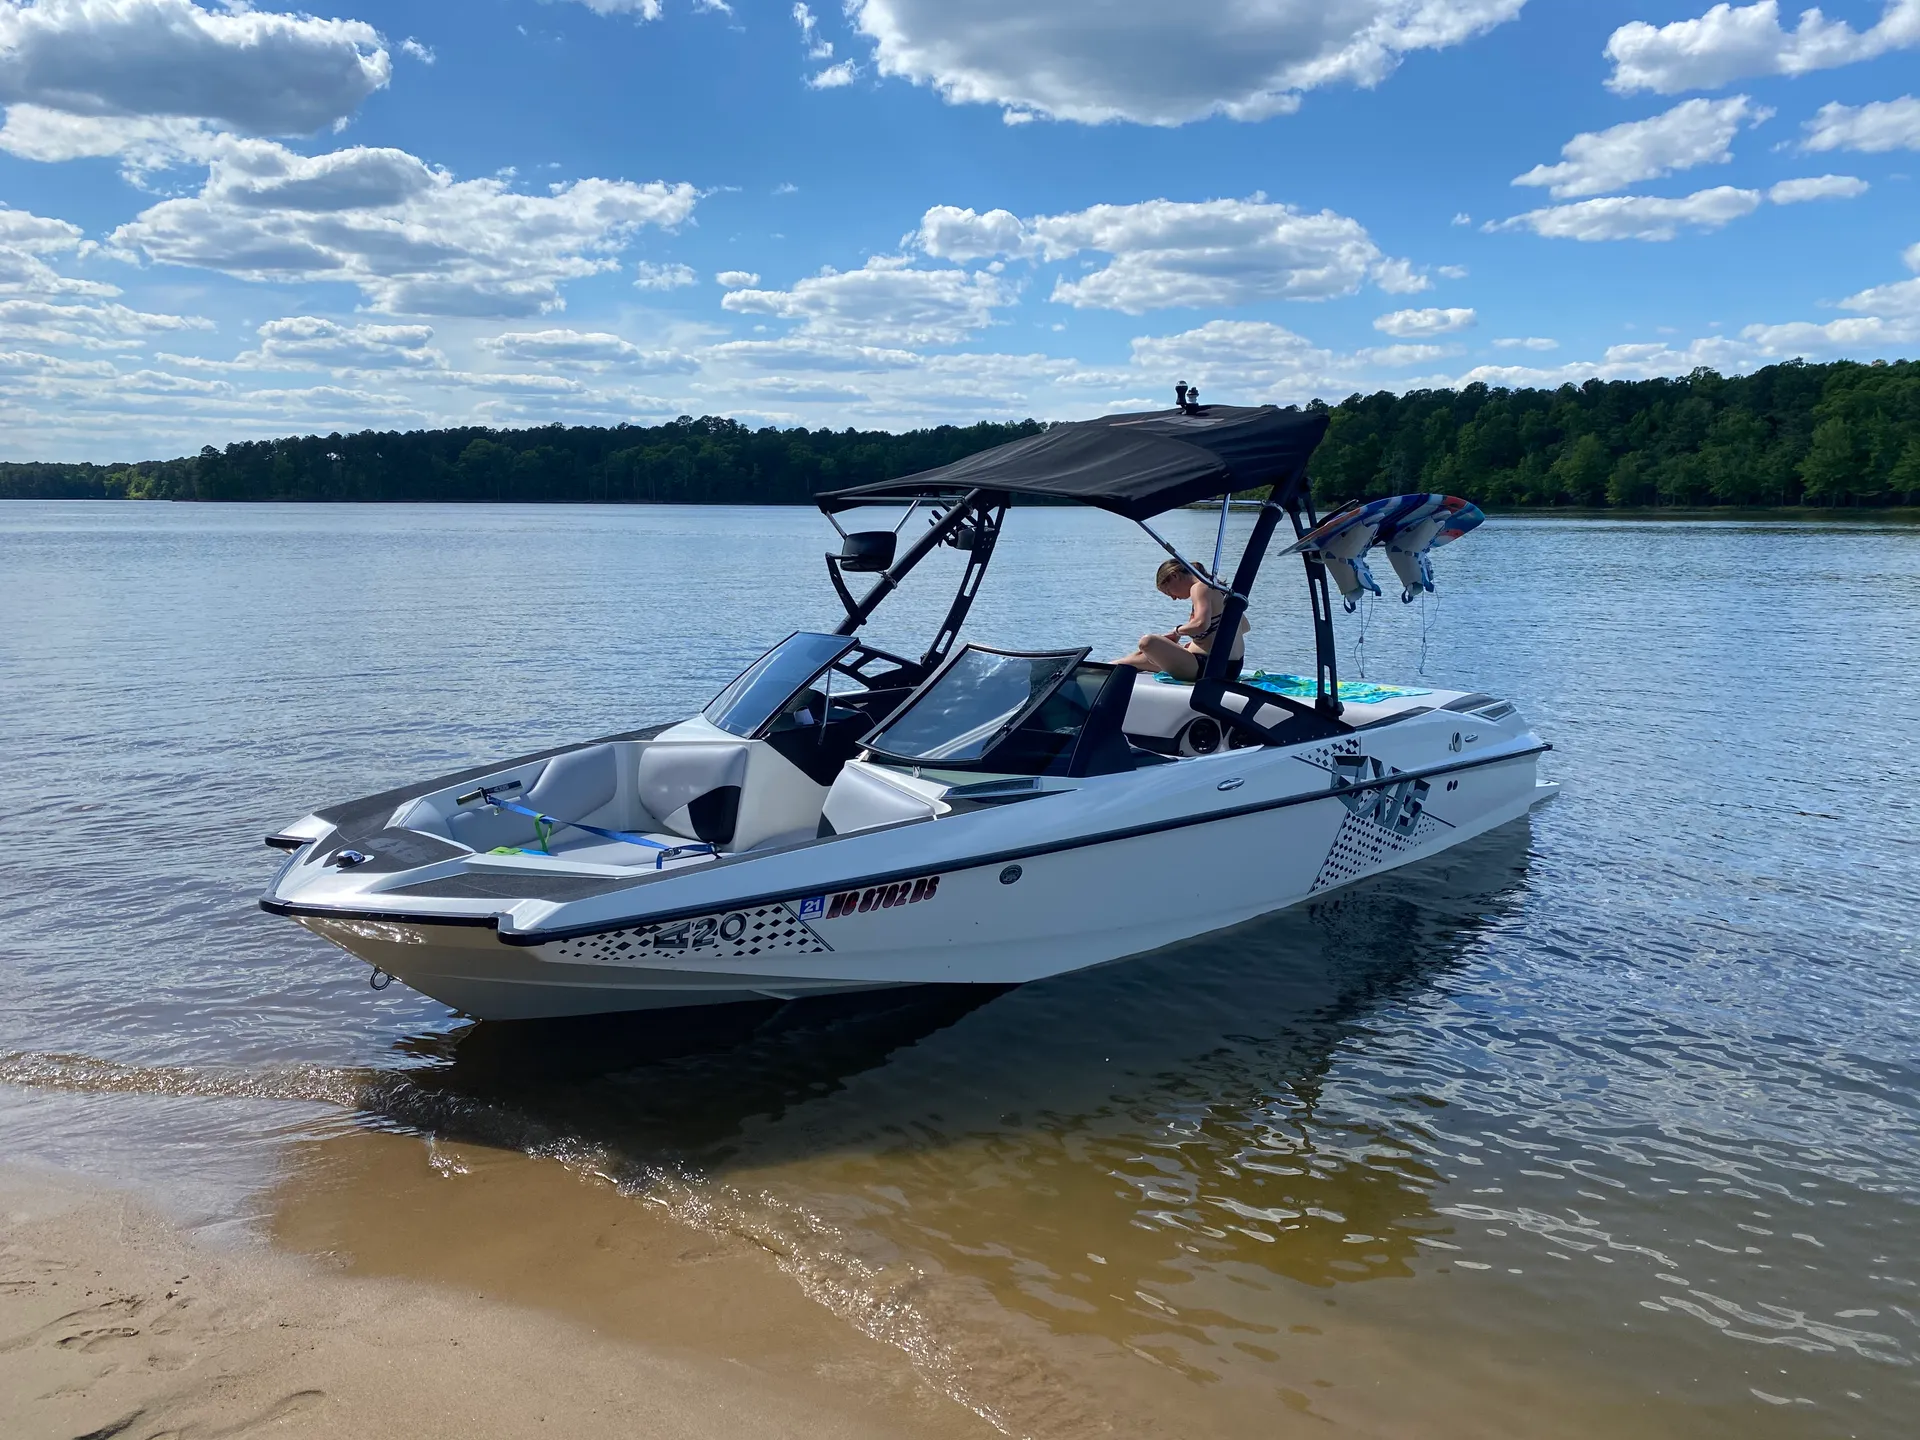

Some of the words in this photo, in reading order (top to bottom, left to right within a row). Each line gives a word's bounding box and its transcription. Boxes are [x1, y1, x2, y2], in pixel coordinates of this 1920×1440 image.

[803, 899, 821, 913] 21
[825, 891, 860, 919] NC
[858, 881, 912, 913] 8702
[908, 875, 940, 903] DS
